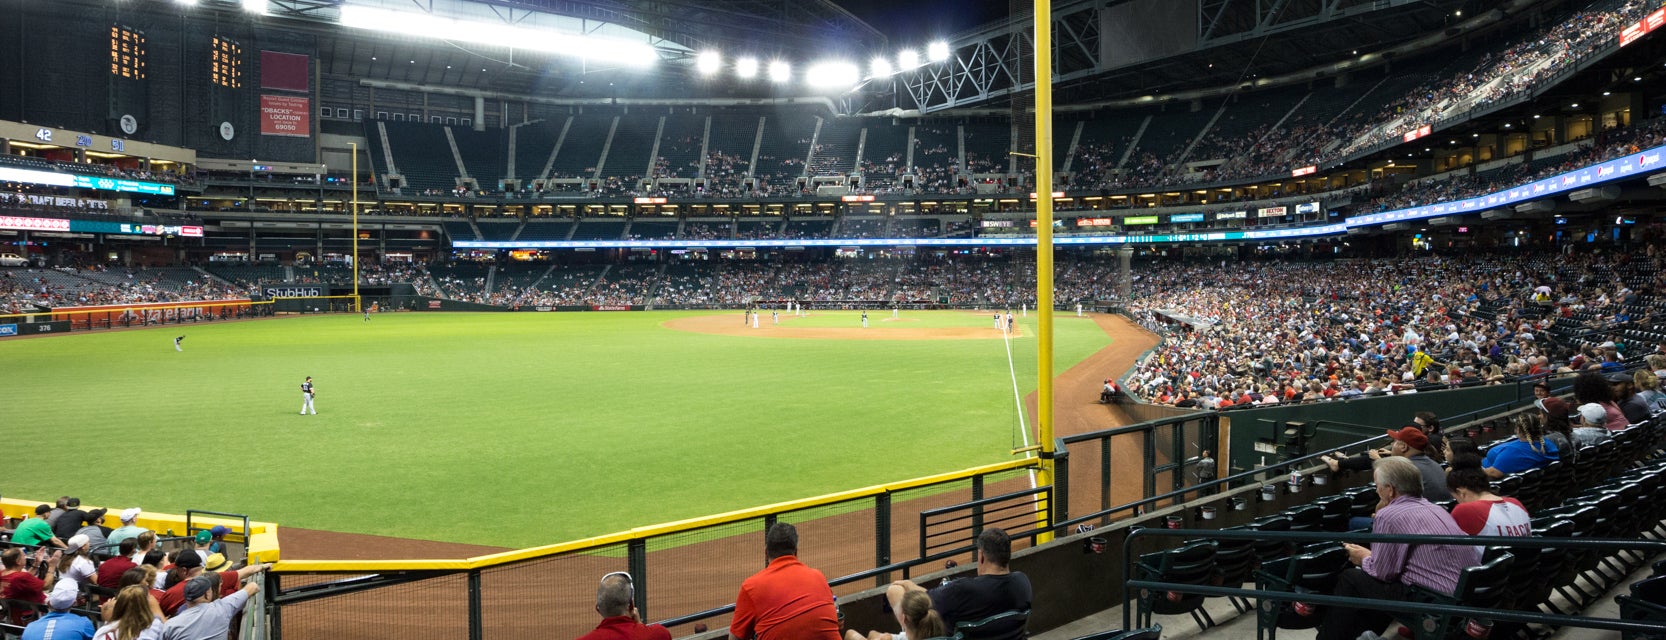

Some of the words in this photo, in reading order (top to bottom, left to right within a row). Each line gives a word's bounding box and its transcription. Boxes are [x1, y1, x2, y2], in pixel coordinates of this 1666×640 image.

[36, 128, 52, 141] 42
[76, 135, 93, 147] 20
[111, 139, 124, 151] 51
[267, 288, 319, 298] StubHub
